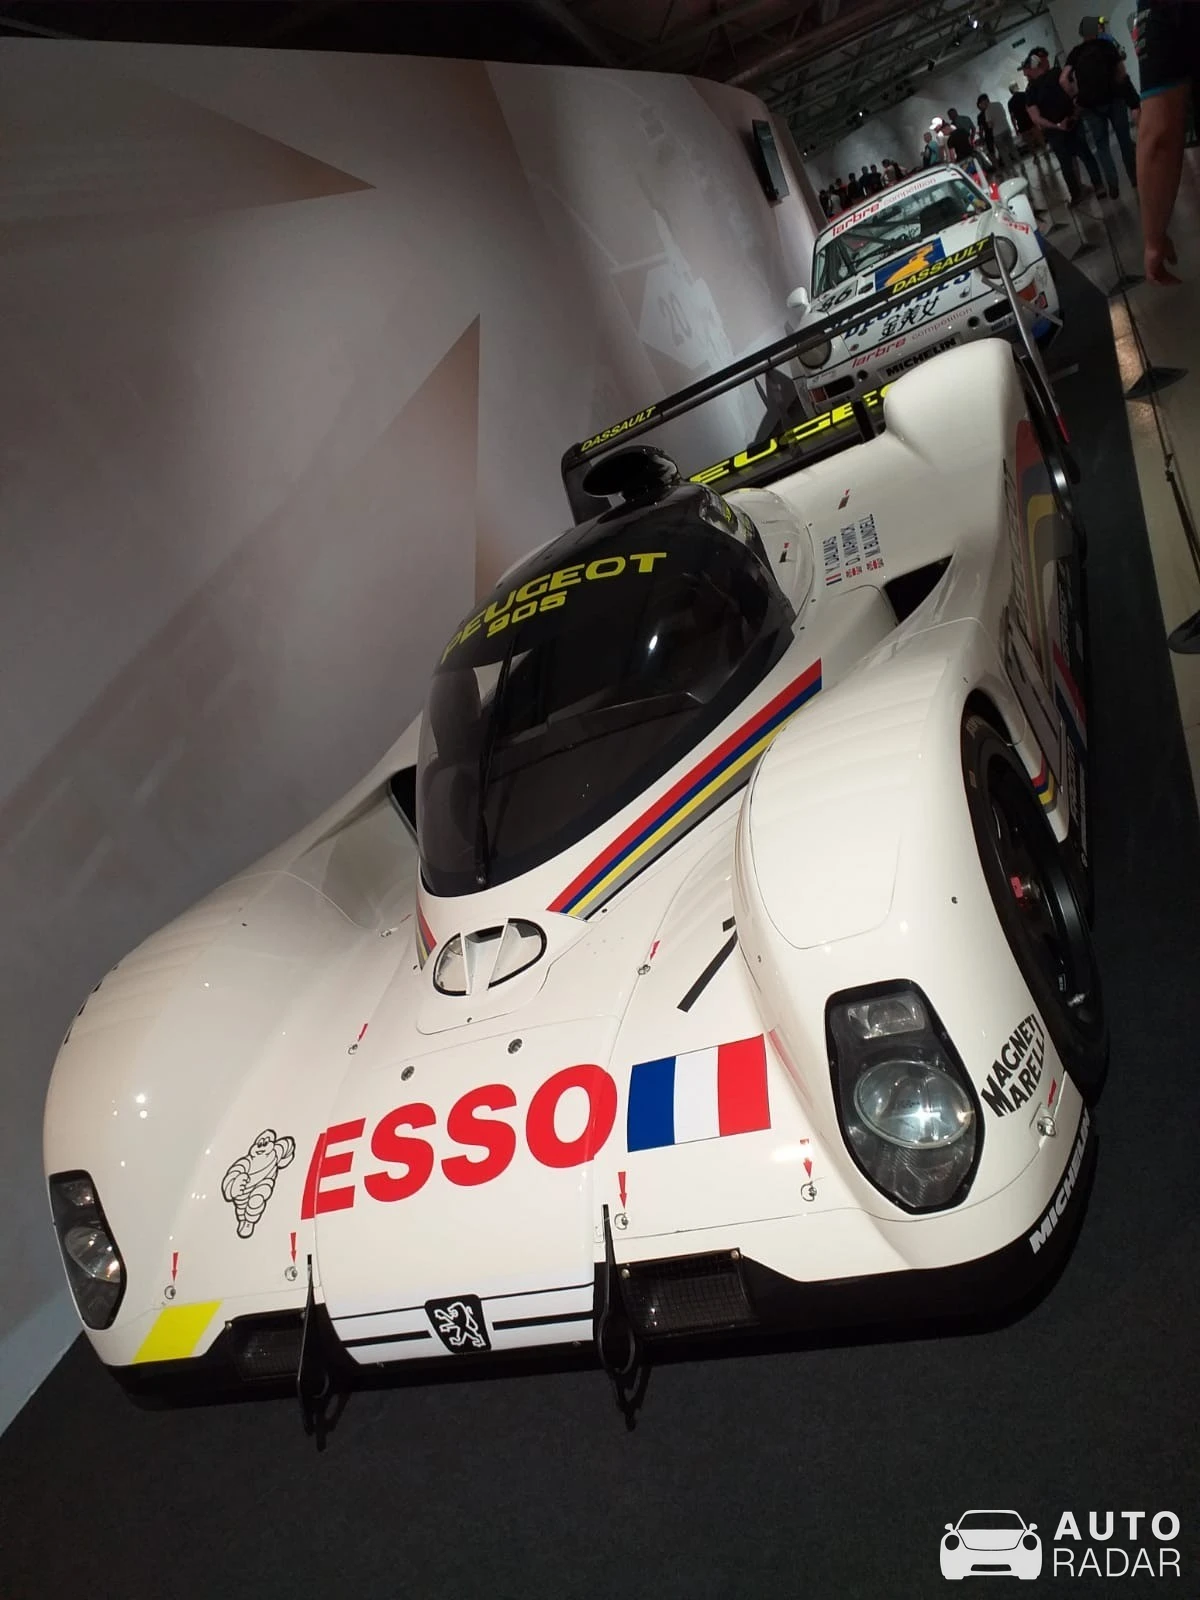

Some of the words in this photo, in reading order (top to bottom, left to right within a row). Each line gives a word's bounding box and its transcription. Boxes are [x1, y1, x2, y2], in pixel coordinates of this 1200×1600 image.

[832, 202, 880, 236] larbre
[892, 237, 990, 294] DASSAULT
[851, 336, 907, 369] larbre
[885, 337, 957, 377] MICHELIN
[580, 405, 657, 453] DASSAULT
[440, 551, 668, 665] PEUGEOT
[486, 590, 568, 639] 905
[300, 1063, 618, 1221] ESSO
